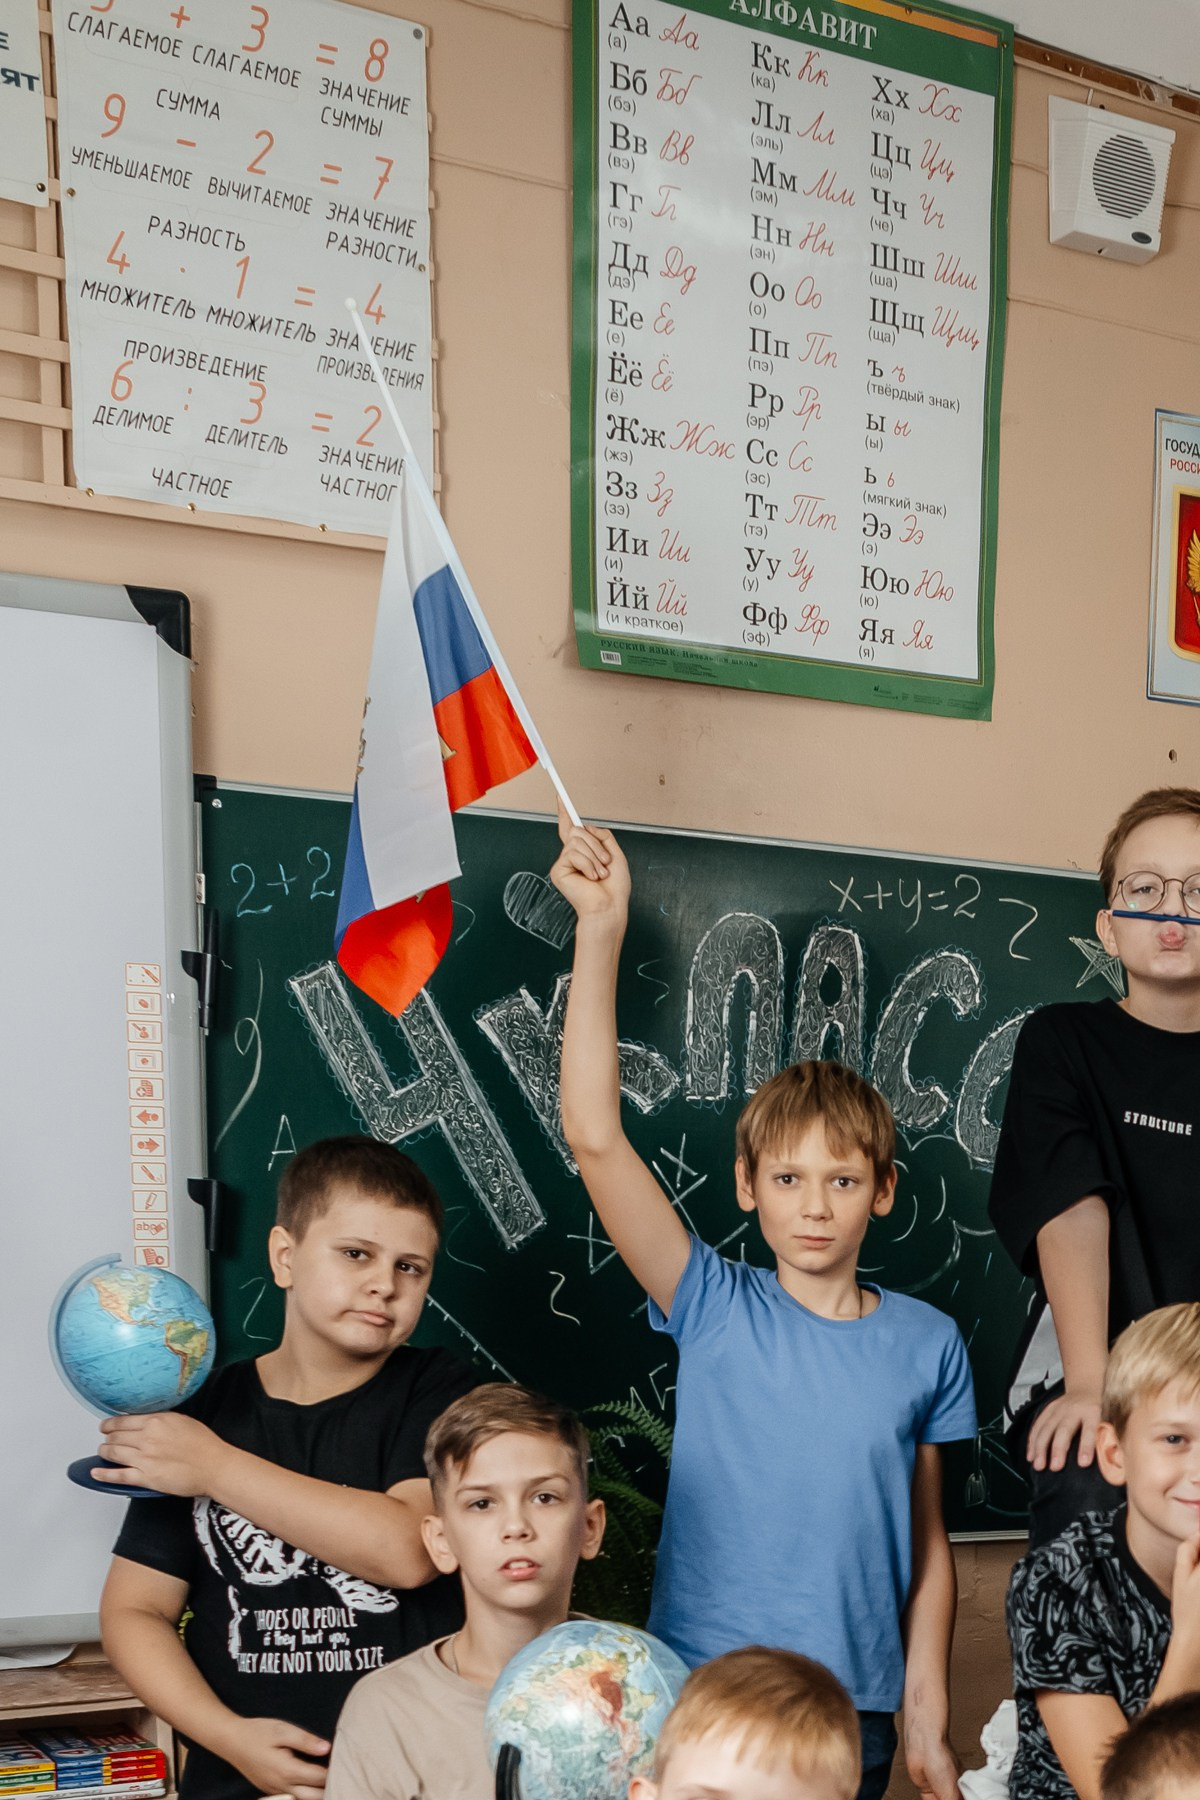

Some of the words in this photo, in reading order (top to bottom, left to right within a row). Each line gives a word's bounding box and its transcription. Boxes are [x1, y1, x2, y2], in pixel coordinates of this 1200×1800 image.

[609, 2, 650, 37] Аа
[729, 0, 877, 50] АЛФАВИТ
[241, 4, 269, 52] 3
[364, 38, 389, 82] 8
[751, 41, 790, 77] Кк
[67, 12, 183, 59] СЛАГАЕМОЕ
[192, 44, 302, 89] СЛАГАЕМОЕ
[319, 77, 411, 116] ЗНАЧЕНИЕ
[610, 61, 647, 96] Бб
[156, 88, 221, 120] СУММА
[871, 75, 910, 110] Хх
[321, 106, 384, 137] СУММЫ
[751, 100, 791, 135] Лл
[101, 93, 126, 137] 9
[246, 129, 275, 175] 2
[372, 156, 394, 200] 7
[609, 121, 647, 155] Вв
[750, 132, 784, 153] (эль)
[870, 131, 911, 170] Цц
[71, 146, 193, 190] УМЕНЬШАЕМОЕ
[207, 176, 313, 215] ВЫЧИТАЕМОЕ
[325, 202, 417, 238] ЗНАЧЕНИЕ
[751, 157, 797, 193] Мм
[609, 181, 643, 212] Гг
[871, 186, 907, 220] Чч
[148, 215, 246, 252] РАЗНОСТЬ
[751, 214, 791, 248] Нн
[326, 234, 418, 268] РАЗНОСТИ
[608, 240, 649, 278] Дд
[870, 241, 925, 279] Шш
[106, 230, 131, 274] 4
[235, 256, 251, 299] 1
[365, 283, 386, 325] 4
[749, 271, 785, 302] Оо
[80, 279, 196, 319] МНОЖИТЕЛЬ
[206, 304, 317, 343] МНОЖИТЕЛЬ
[608, 298, 644, 329] Ее
[870, 296, 924, 338] Щщ
[749, 326, 789, 359] Пп
[124, 340, 268, 382] ПРОИЗВЕДЕНИЕ
[607, 351, 643, 386] Ёё
[110, 360, 134, 401] 6
[240, 381, 267, 425] 3
[356, 405, 382, 447] 2
[749, 382, 783, 417] Рр
[866, 379, 924, 406] (твёрдый
[928, 392, 960, 413] знак)
[92, 405, 175, 435] ДЕЛИМОЕ
[205, 425, 289, 455] ДЕЛИТЕЛЬ
[607, 414, 666, 449] Жж
[746, 439, 778, 467] Сс
[151, 467, 232, 499] ЧАСТНОЕ
[320, 473, 399, 502] ЧАСТНОГ
[606, 471, 638, 499] Зз
[745, 493, 778, 522] Тт
[862, 491, 911, 511] (мягкий
[915, 498, 947, 519] знак)
[606, 526, 649, 557] Ии
[862, 512, 891, 541] Ээ
[744, 546, 780, 580] Уу
[860, 564, 909, 596] Юю
[607, 576, 649, 612] Йй
[606, 609, 621, 626] (и
[624, 612, 684, 634] краткое)
[743, 601, 788, 634] Фф
[858, 618, 895, 646] Яя
[1123, 1111, 1193, 1137] STRUCTURE
[292, 1608, 310, 1630] OR
[259, 1653, 280, 1673] ARE
[283, 1652, 312, 1673] NOT
[316, 1650, 353, 1672] YOUR
